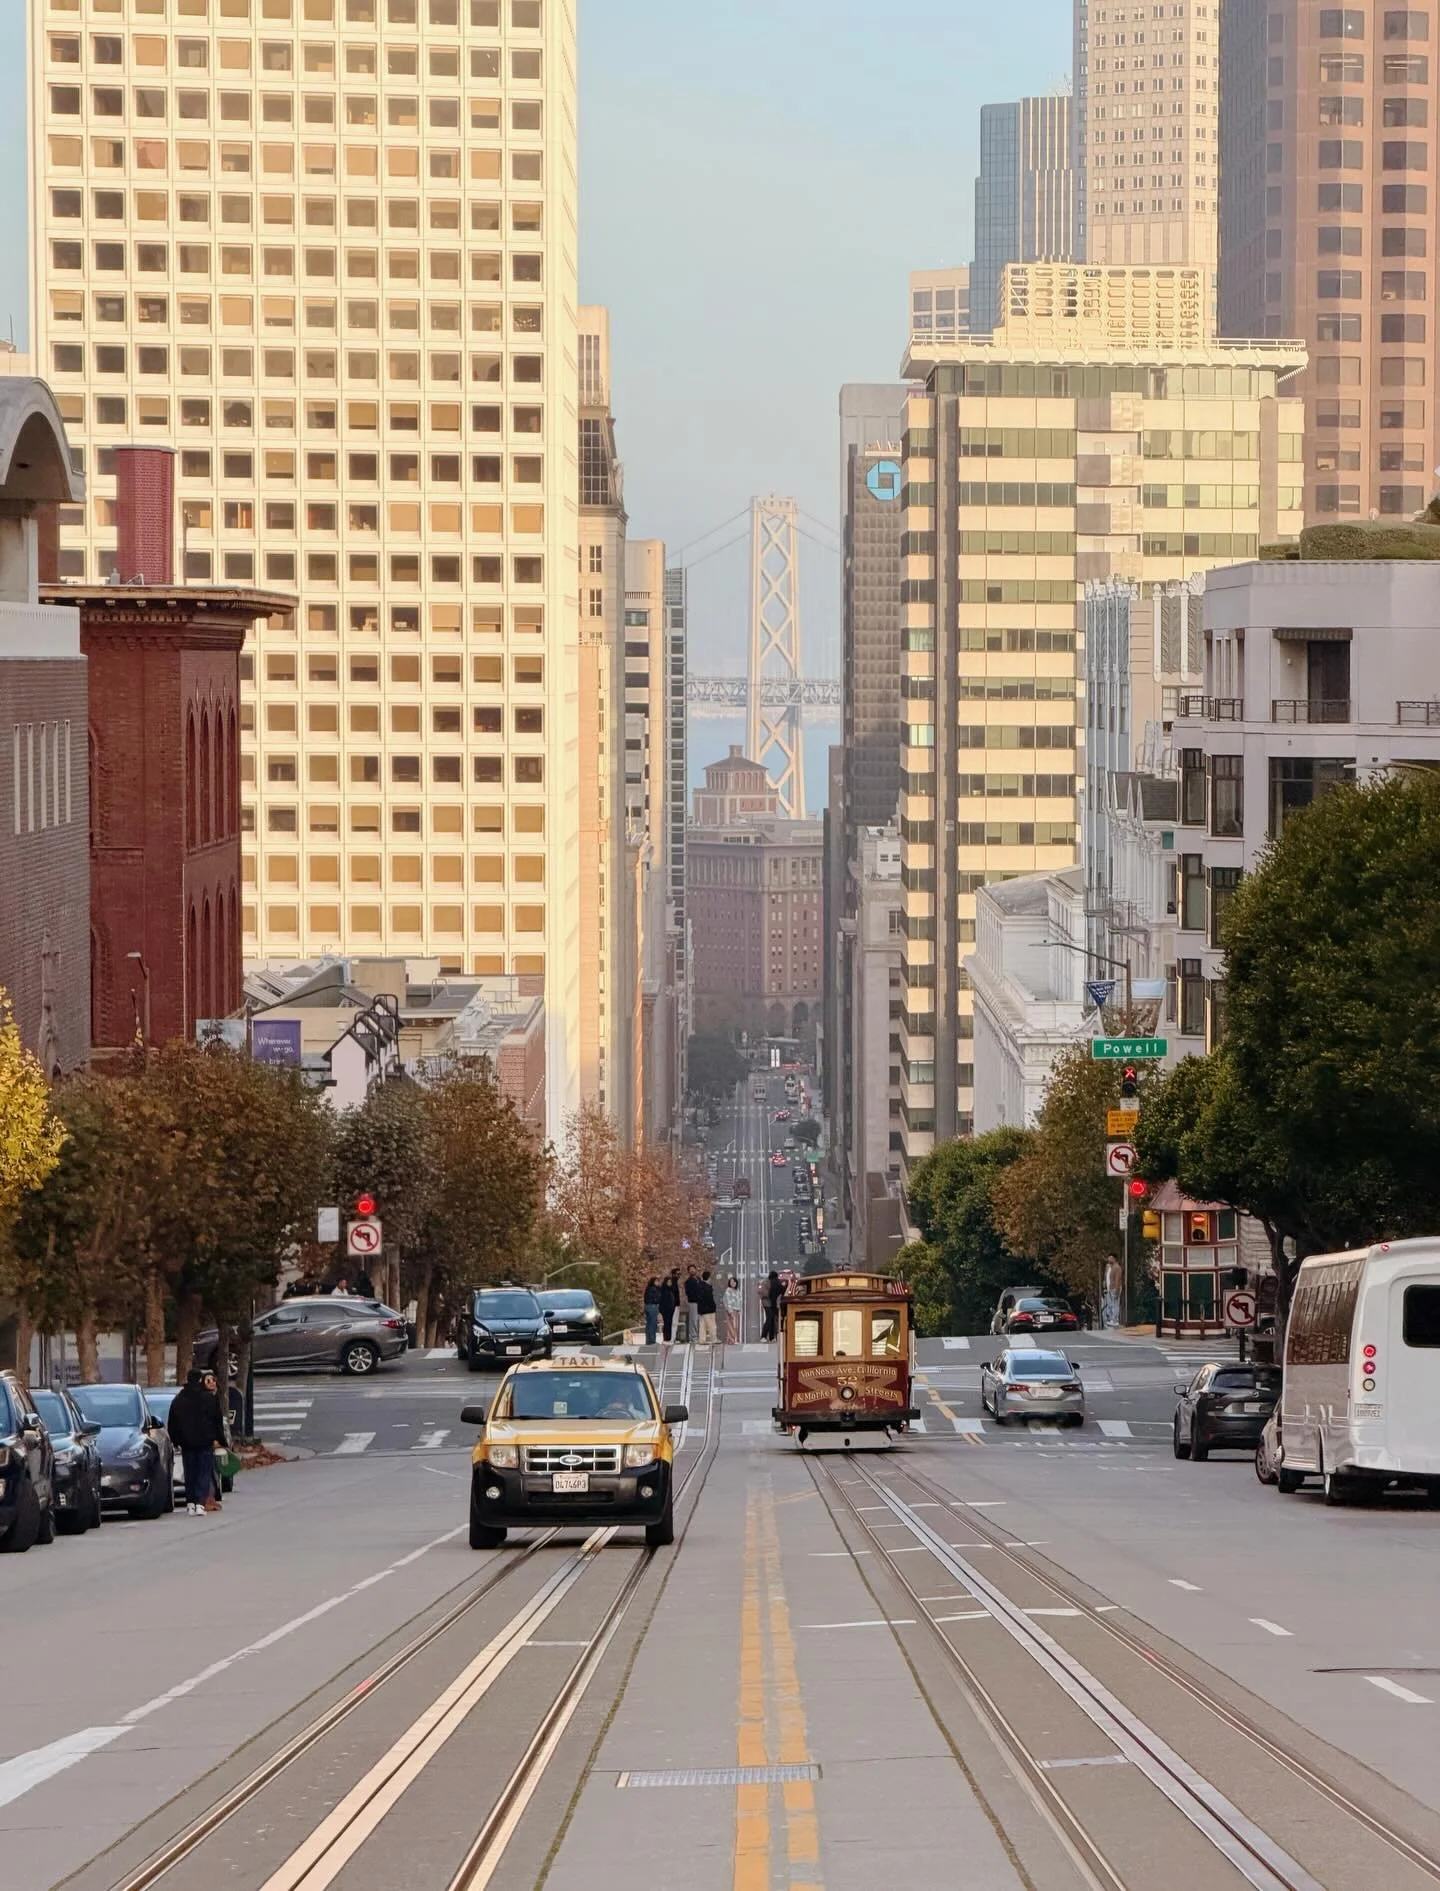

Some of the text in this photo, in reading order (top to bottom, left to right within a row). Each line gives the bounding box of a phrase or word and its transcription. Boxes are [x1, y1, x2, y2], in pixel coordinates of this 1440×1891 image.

[257, 1037, 291, 1046] Wherever
[1103, 1043, 1157, 1054] Powell
[559, 1356, 596, 1366] TAXI
[800, 1369, 815, 1378] Van
[815, 1368, 834, 1376] Ness
[856, 1366, 897, 1376] California
[837, 1376, 858, 1385] 52
[796, 1389, 833, 1402] & Market
[865, 1386, 898, 1399] Streets
